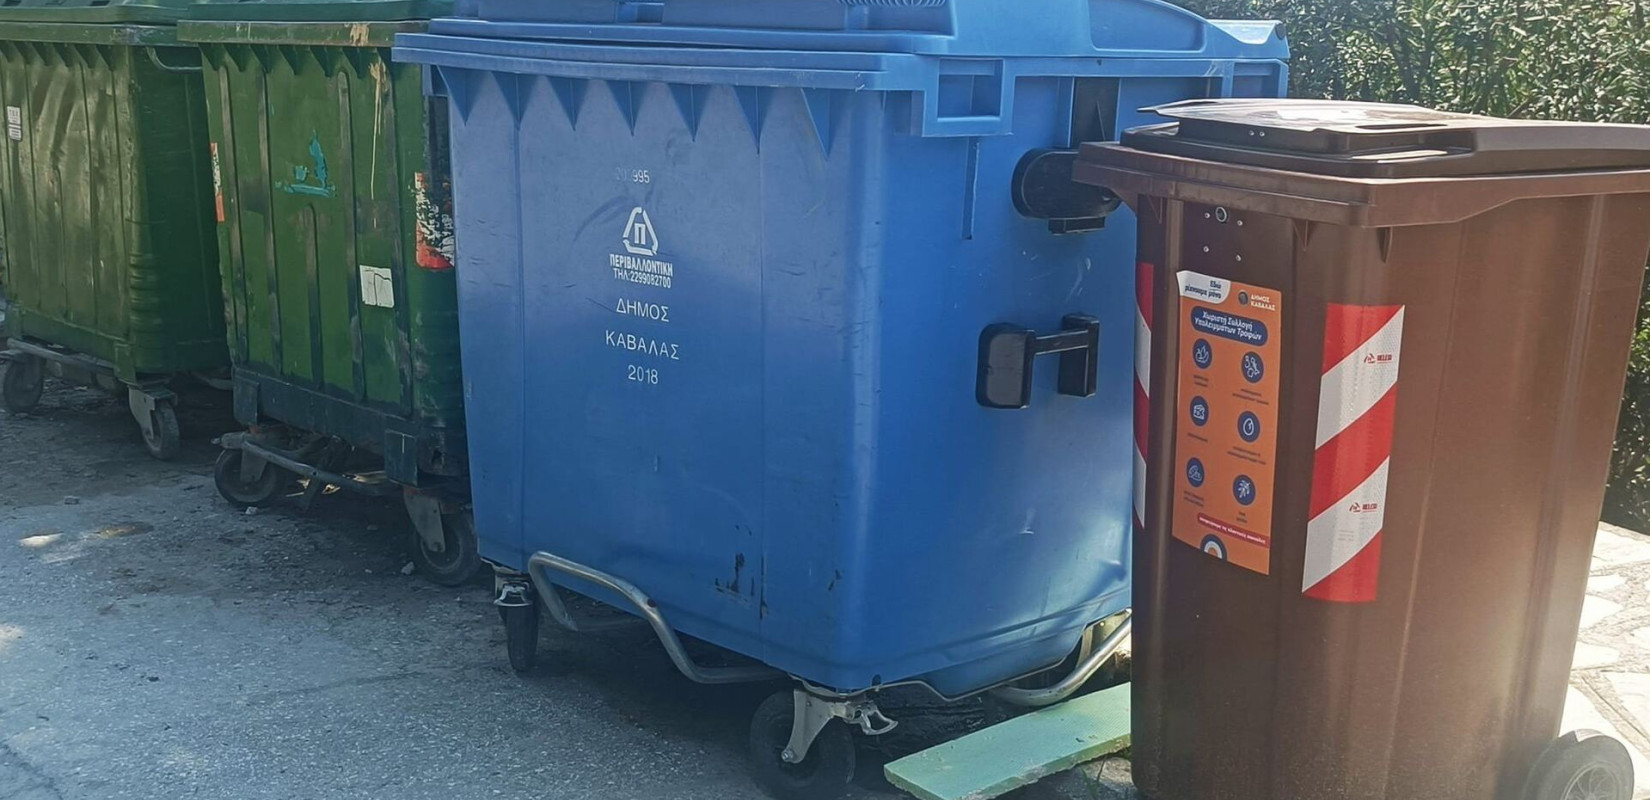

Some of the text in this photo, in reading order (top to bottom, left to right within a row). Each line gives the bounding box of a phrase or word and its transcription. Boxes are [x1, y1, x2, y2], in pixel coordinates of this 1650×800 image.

[634, 223, 646, 245] Π
[609, 254, 673, 277] ΠΕΡΙΒΑΛΛΟΝΤΙΚΗ
[1251, 294, 1270, 302] ΔΗΜΟΣ
[1251, 301, 1275, 311] ΚΑΒΑΛΑΣ
[616, 298, 670, 322] ΔΗΜΟΣ
[1203, 310, 1253, 332] Χωριστή Συλλογή
[606, 329, 680, 360] ΚΑΒΑΛΑΣ
[1237, 327, 1262, 341] Τροφών
[628, 365, 659, 385] 2018
